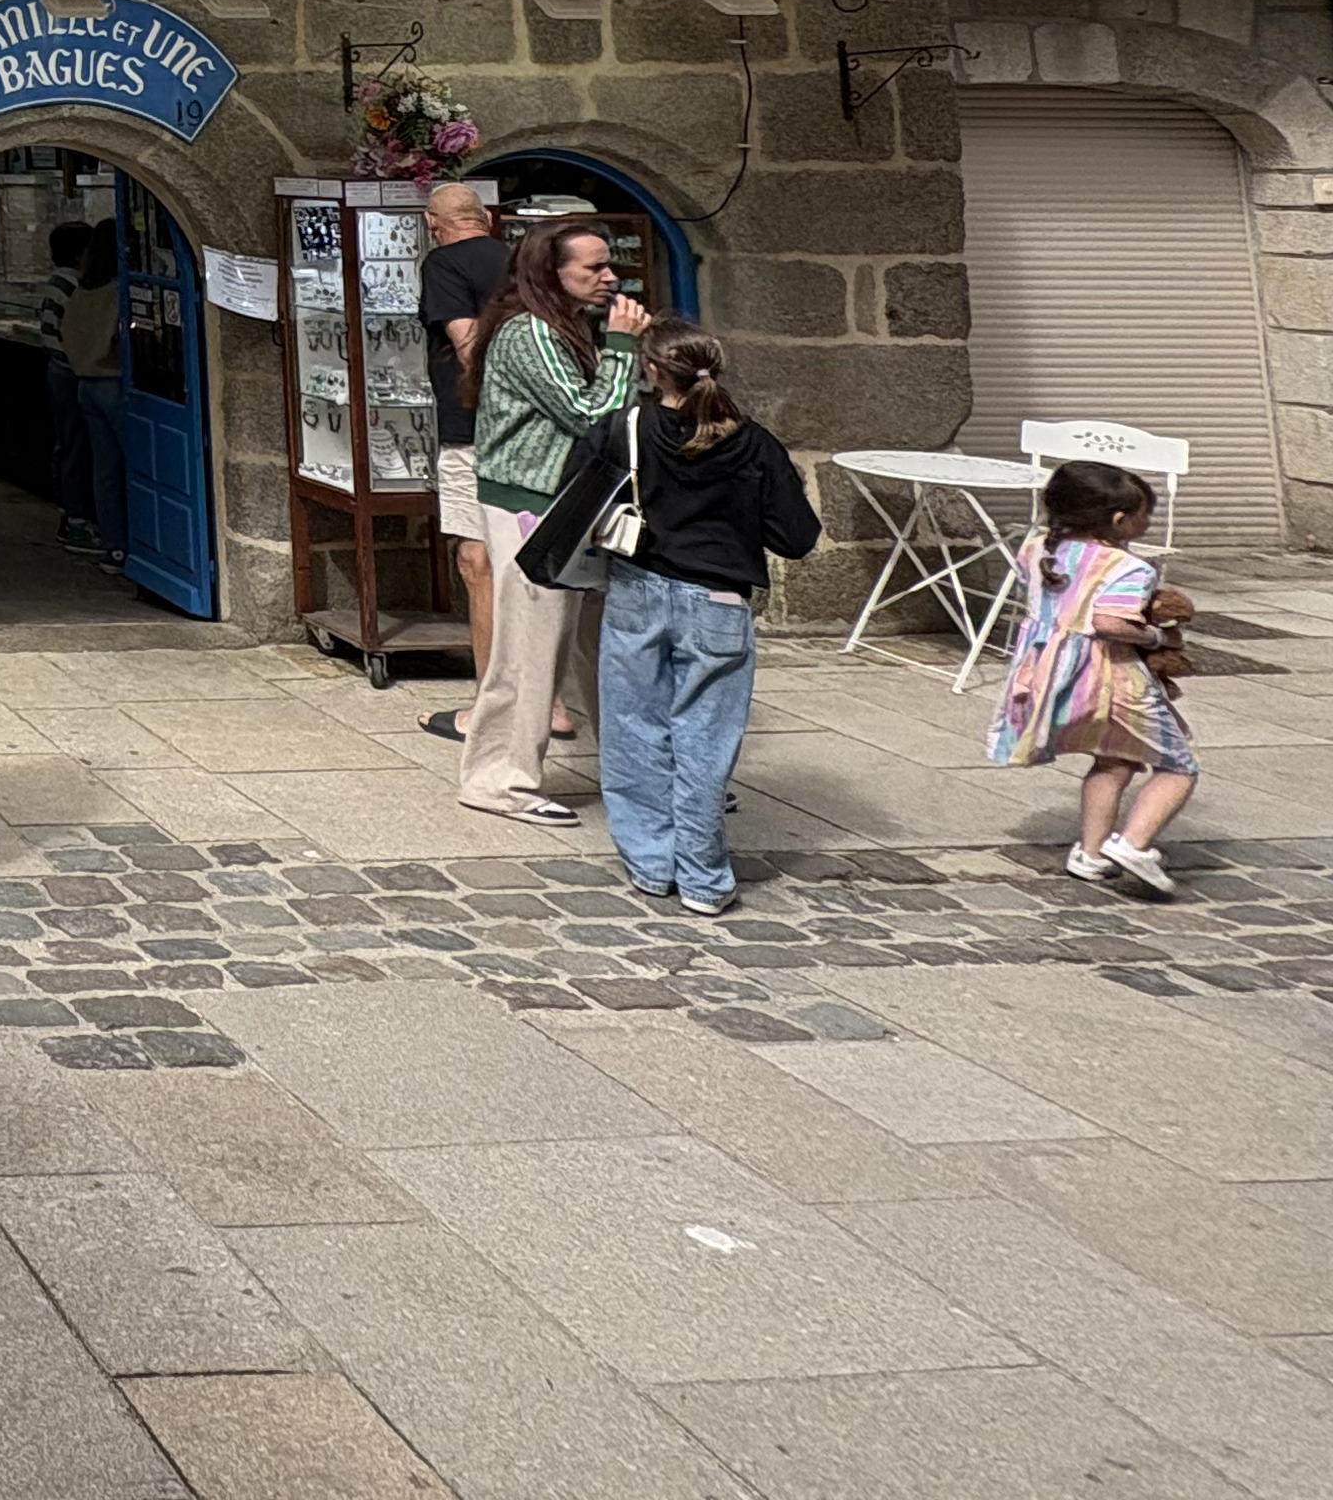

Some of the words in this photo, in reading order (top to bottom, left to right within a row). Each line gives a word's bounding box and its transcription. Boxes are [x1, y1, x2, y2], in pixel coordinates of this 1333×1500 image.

[112, 19, 143, 47] ET
[142, 18, 217, 94] UNE
[175, 98, 205, 128] 19
